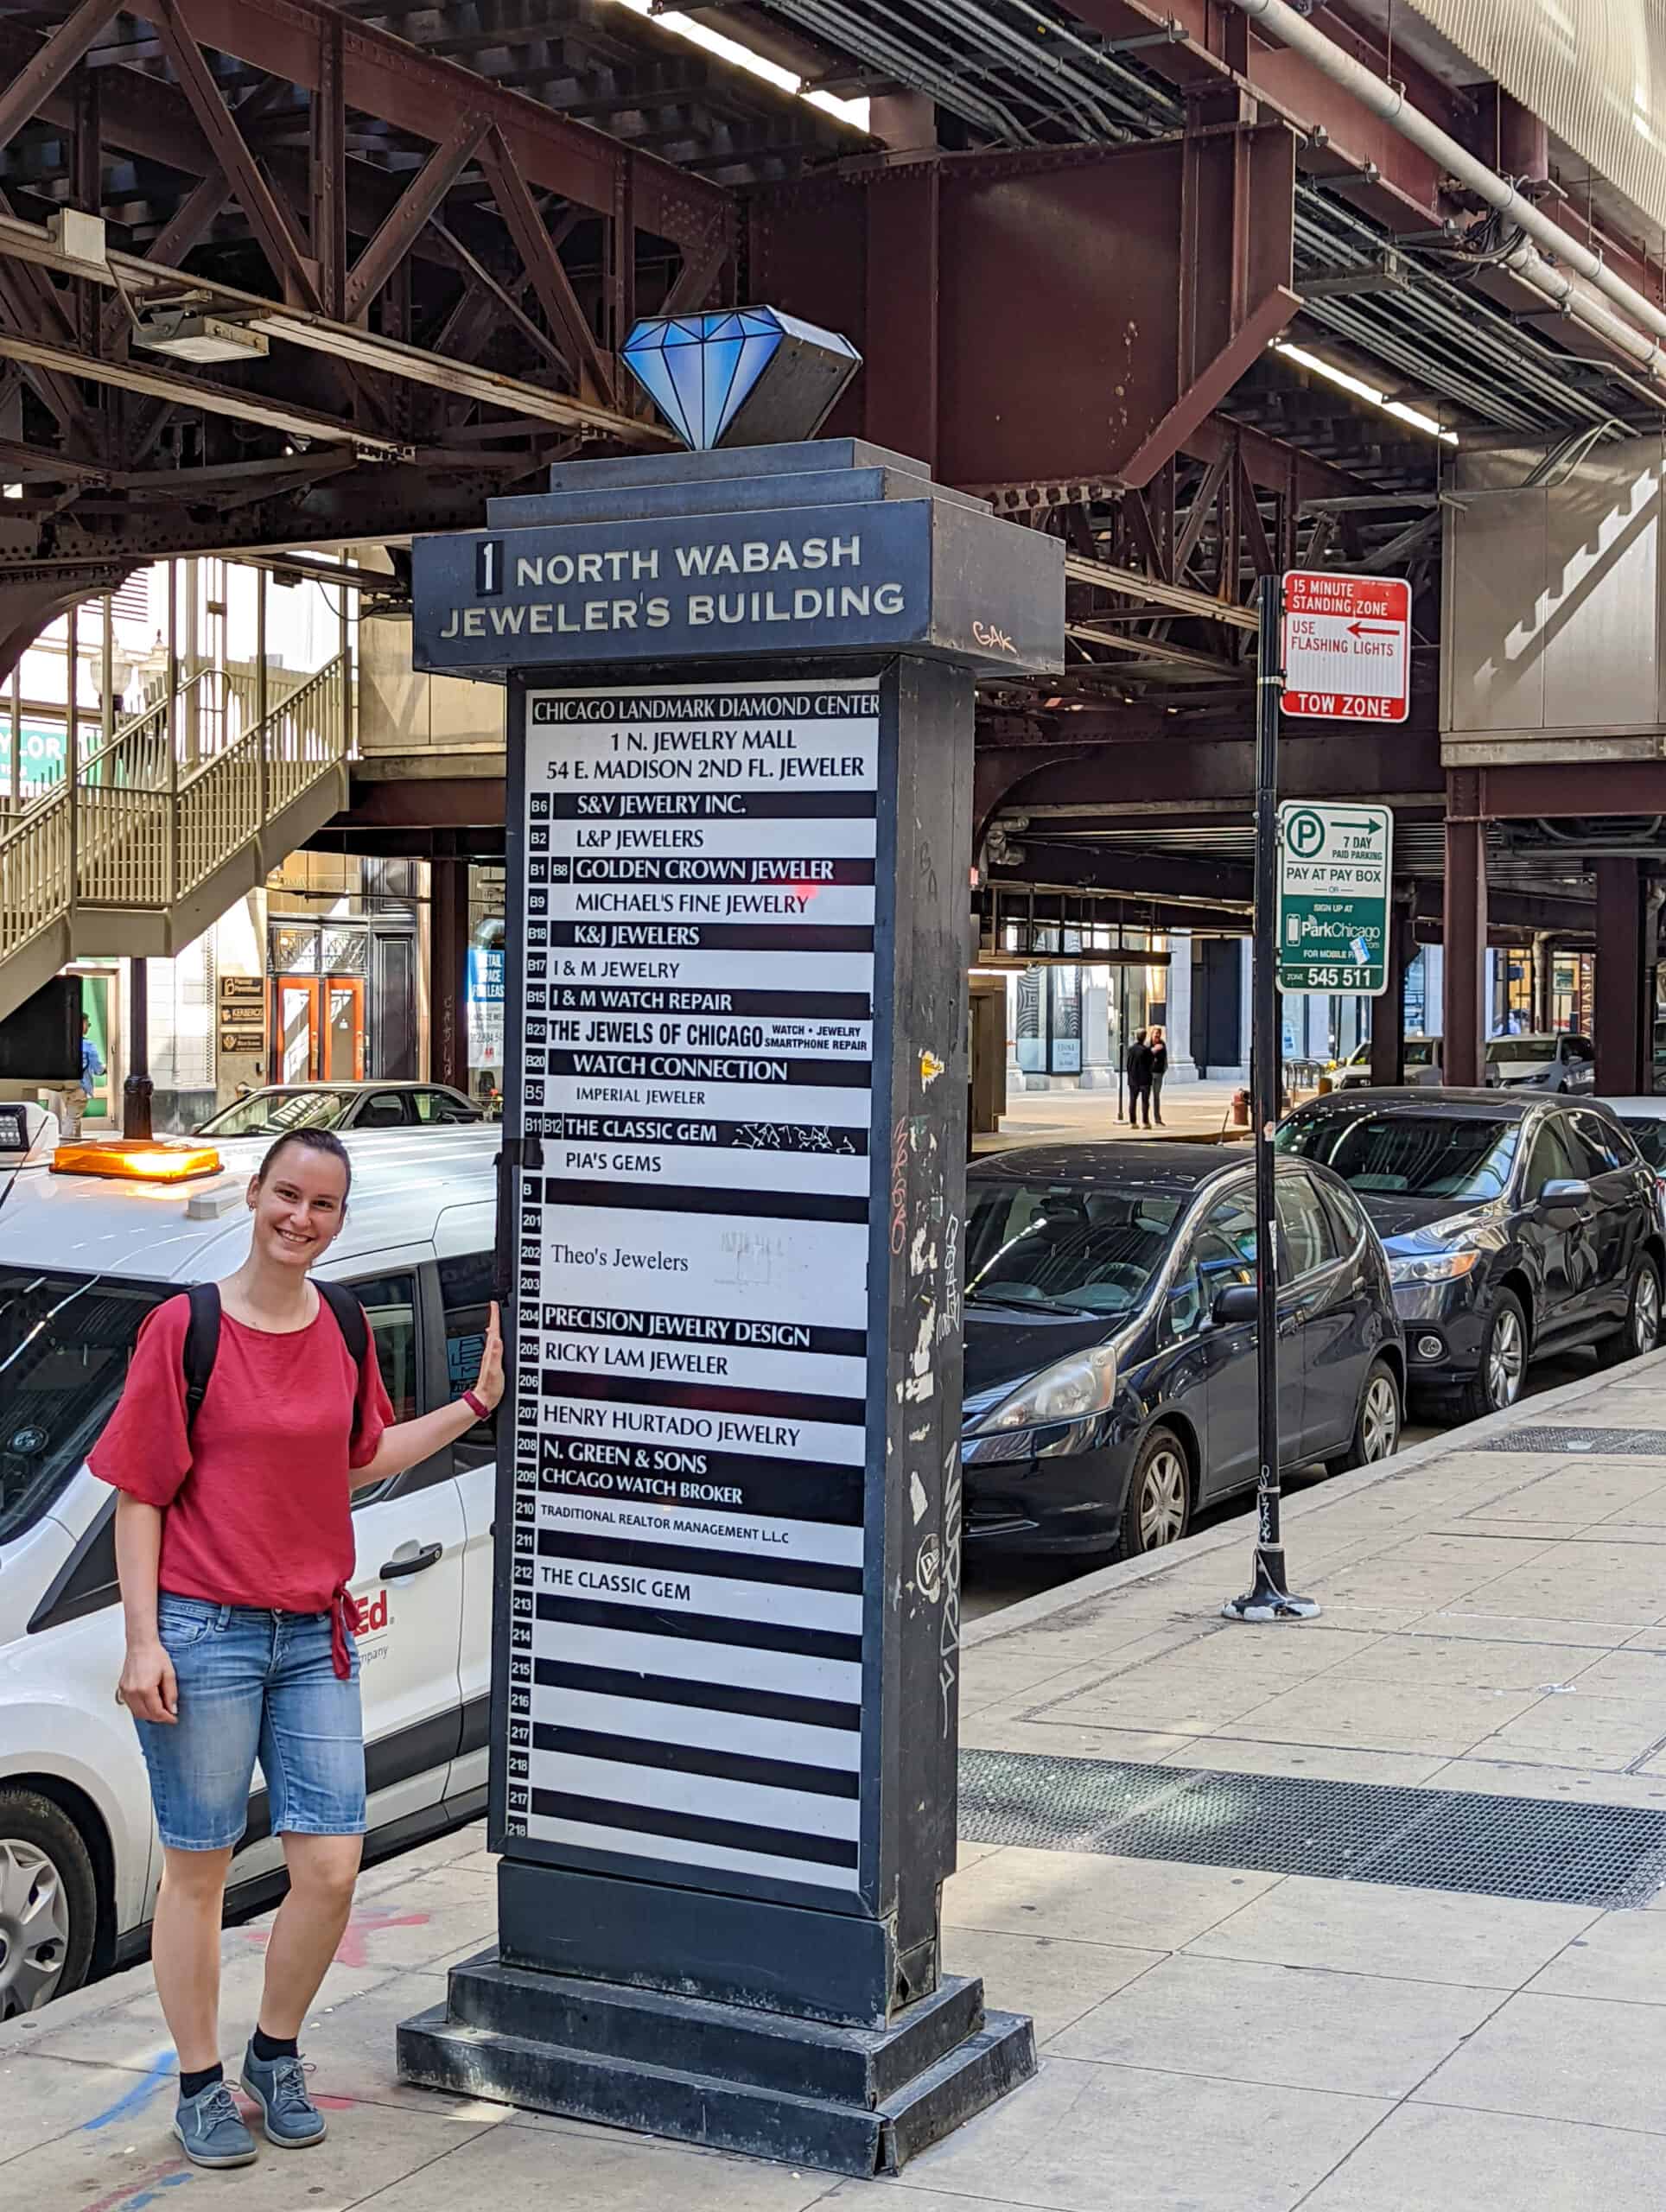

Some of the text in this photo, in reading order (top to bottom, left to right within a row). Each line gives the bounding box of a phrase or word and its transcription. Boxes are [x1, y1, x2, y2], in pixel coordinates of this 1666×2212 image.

[482, 536, 862, 589] 1 NORTH WABASH
[1293, 579, 1354, 597] 15 MINUTE
[441, 583, 906, 638] JEWELER'S BUILDING
[1293, 595, 1388, 616] STANDING ZONE
[1293, 620, 1315, 634] USE
[1291, 637, 1394, 657] FLASHING LIGHTS
[534, 694, 880, 721] CHICAGO LANDMARK DIAMOND CENTER
[1298, 694, 1391, 717] TOW ZONE
[612, 729, 796, 753] 1 N. JEWELRY MALL
[547, 757, 864, 780] 54 E. MADISON 2ND FL. JEWELER
[531, 795, 746, 817] B6 S&V JEWELRY INC.
[531, 830, 703, 850] B2 L&P JEWELERS
[1298, 820, 1316, 848] P
[1343, 836, 1372, 849] 7 DAY
[1332, 850, 1383, 860] PAID PARKING
[531, 861, 834, 881] B1 B8 GOLDEN CROWN JEWELER
[1287, 867, 1382, 882] PAY AT PAY BOX
[530, 893, 809, 916] B9 MICHAEL'S FINE JEWELRY
[1313, 904, 1331, 912] SIGN
[1332, 904, 1343, 912] UP
[528, 925, 700, 945] B18 K&J JEWELERS
[1301, 921, 1380, 941] ParkChicago
[1303, 950, 1319, 958] FOR
[1319, 950, 1347, 958] MOBILE
[528, 960, 680, 979] B17 I & M JEWELRY
[1307, 968, 1338, 986] 545
[1343, 969, 1370, 986] 511
[527, 990, 732, 1011] B15 I & M WATCH REPAIR
[526, 1019, 763, 1048] B23 THE JEWELS OF CHICAGO
[772, 1025, 862, 1037] WATCH JEWELRY
[764, 1038, 868, 1051] SMARTPHONE REPAIR
[525, 1054, 788, 1081] B20 WATCH CONNECTION
[525, 1086, 705, 1105] B5 IMPERIAL JEWELER
[525, 1118, 542, 1132] B11
[545, 1118, 562, 1133] B12
[565, 1118, 599, 1136] THE
[603, 1120, 672, 1140] CLASSIC
[677, 1122, 717, 1142] GEM
[565, 1152, 662, 1173] PIA'S GEMS
[524, 1183, 532, 1195] B
[523, 1215, 541, 1227] 201
[521, 1243, 689, 1272] 202 Theo's Jewelers
[520, 1277, 540, 1289] 203
[519, 1306, 811, 1347] 204 PRECISION JEWELRY DESIGN
[519, 1342, 728, 1376] 205 RICKY LAM JEWELER
[518, 1375, 538, 1388] 206
[518, 1404, 801, 1446] 207 HENRY HURTADO JEWELRY
[518, 1438, 708, 1475] 208 N. GREEN & SONS
[517, 1468, 743, 1504] 209 CHCAGO WATCH BROKER
[516, 1502, 534, 1515] 210
[541, 1504, 616, 1523] TRADITIONAL
[618, 1513, 671, 1530] REALTOR
[673, 1520, 759, 1540] MANAGEMENT
[516, 1534, 533, 1547] 211
[514, 1566, 690, 1601] 212 THE CLASSIC GEM
[513, 1598, 531, 1611] 213
[512, 1630, 531, 1642] 214
[512, 1662, 530, 1675] 215
[511, 1694, 530, 1707] 216
[511, 1727, 529, 1739] 217
[509, 1758, 528, 1770] 218
[510, 1792, 527, 1804] 217
[508, 1823, 525, 1836] 218
